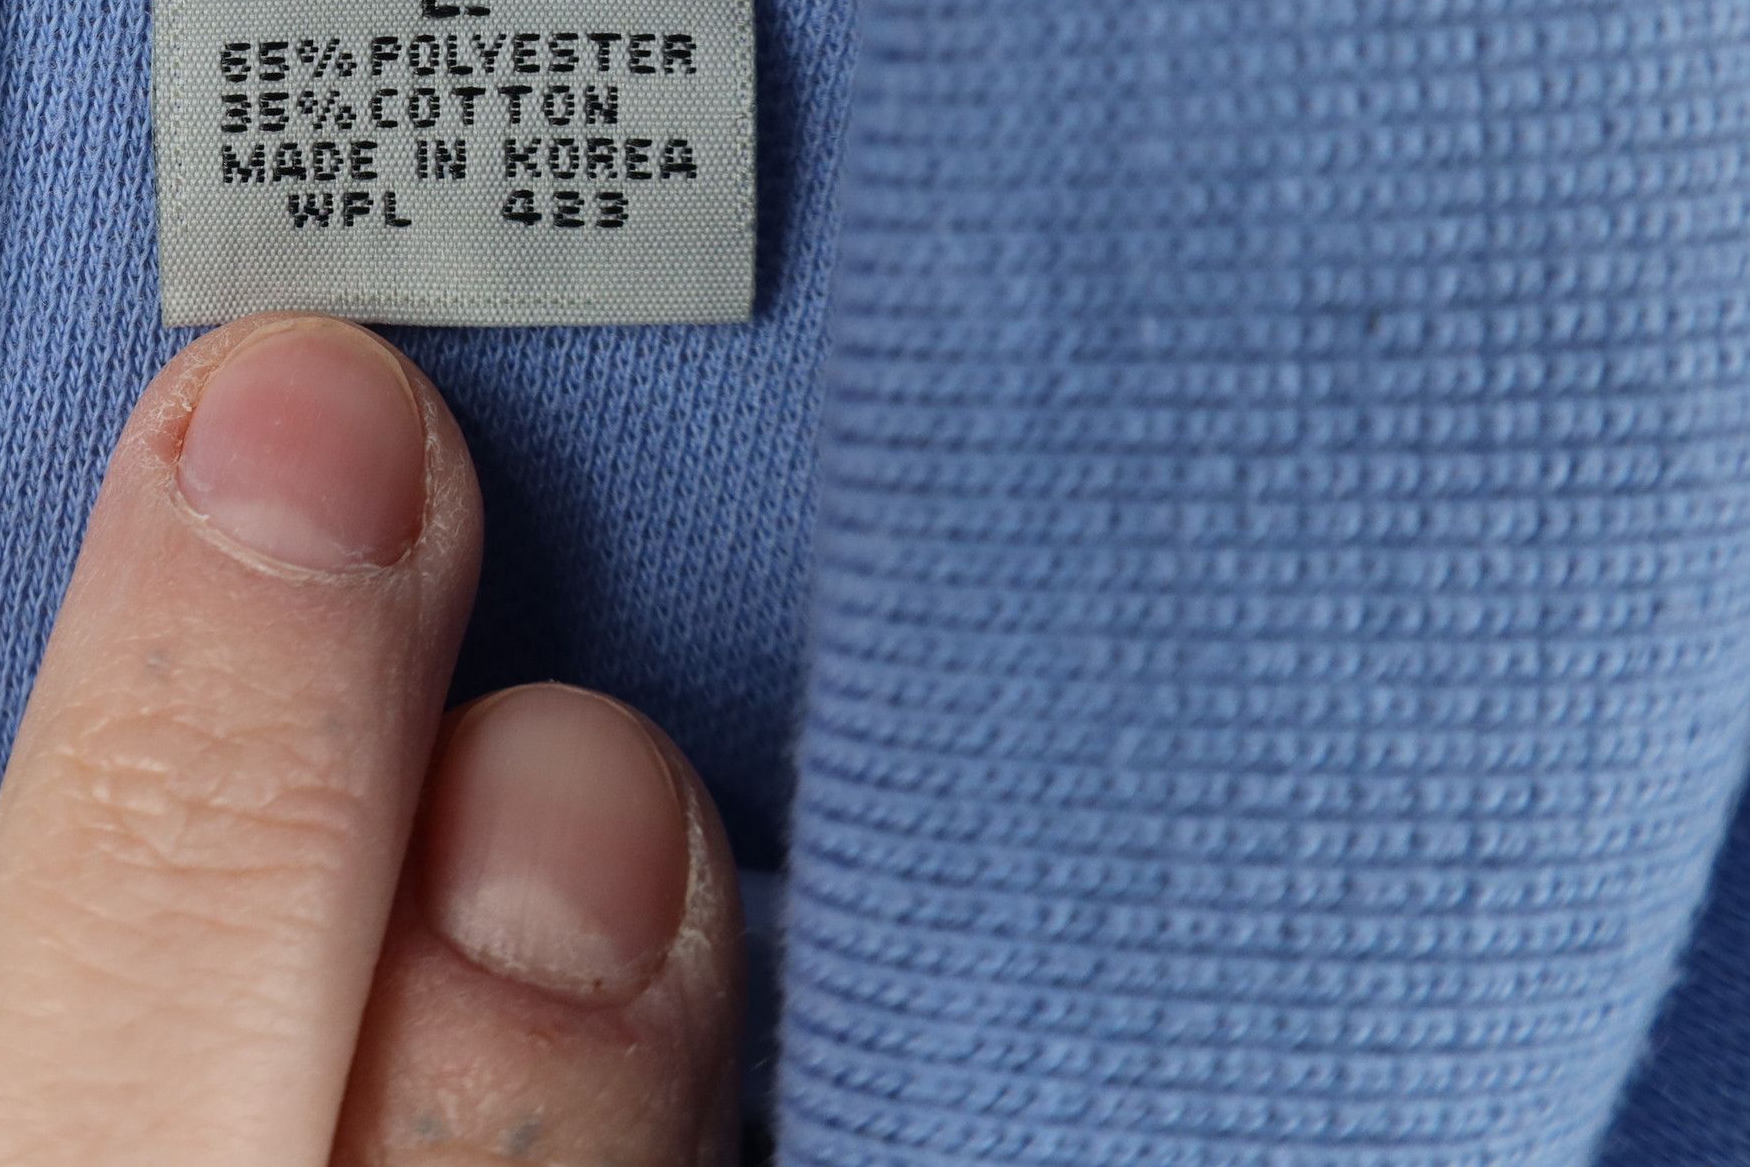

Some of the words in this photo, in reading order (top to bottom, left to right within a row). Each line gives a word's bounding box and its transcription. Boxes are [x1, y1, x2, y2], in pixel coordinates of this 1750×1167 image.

[220, 36, 357, 82] 65%
[371, 32, 697, 76] POLYESTER
[220, 88, 354, 133] 35%
[371, 84, 620, 128] COTTON
[220, 140, 379, 183] MADE
[417, 138, 467, 180] IN
[503, 137, 699, 179] KOREA
[286, 190, 413, 228] WPL
[501, 188, 630, 229] 423
